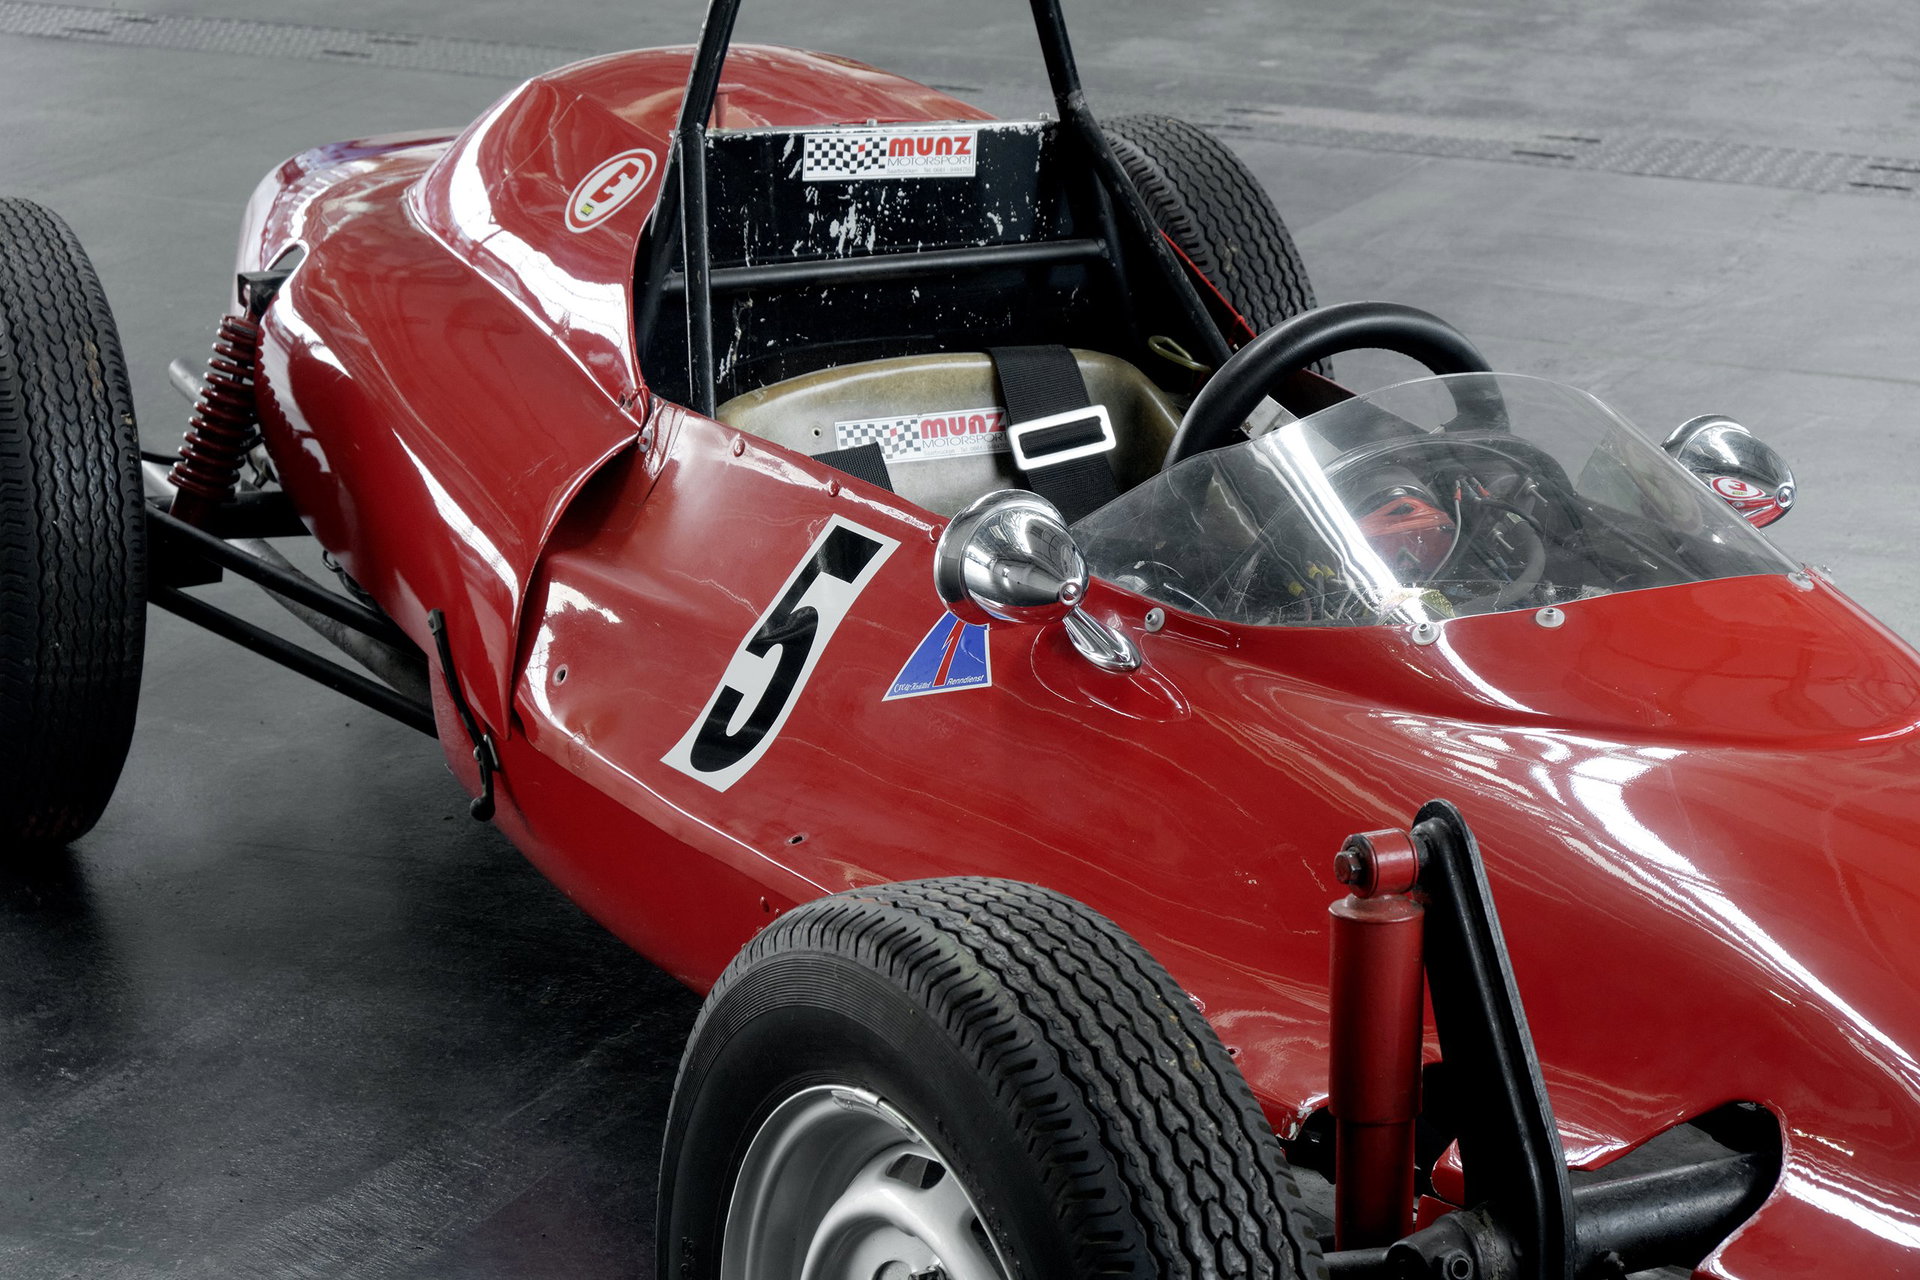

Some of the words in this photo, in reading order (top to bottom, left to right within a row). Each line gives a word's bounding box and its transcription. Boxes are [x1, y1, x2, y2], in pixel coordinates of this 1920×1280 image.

[888, 155, 973, 166] MOTORSPORT
[923, 432, 1008, 449] MOTORSPORT
[690, 525, 884, 772] 5
[947, 674, 985, 686] Renndienst
